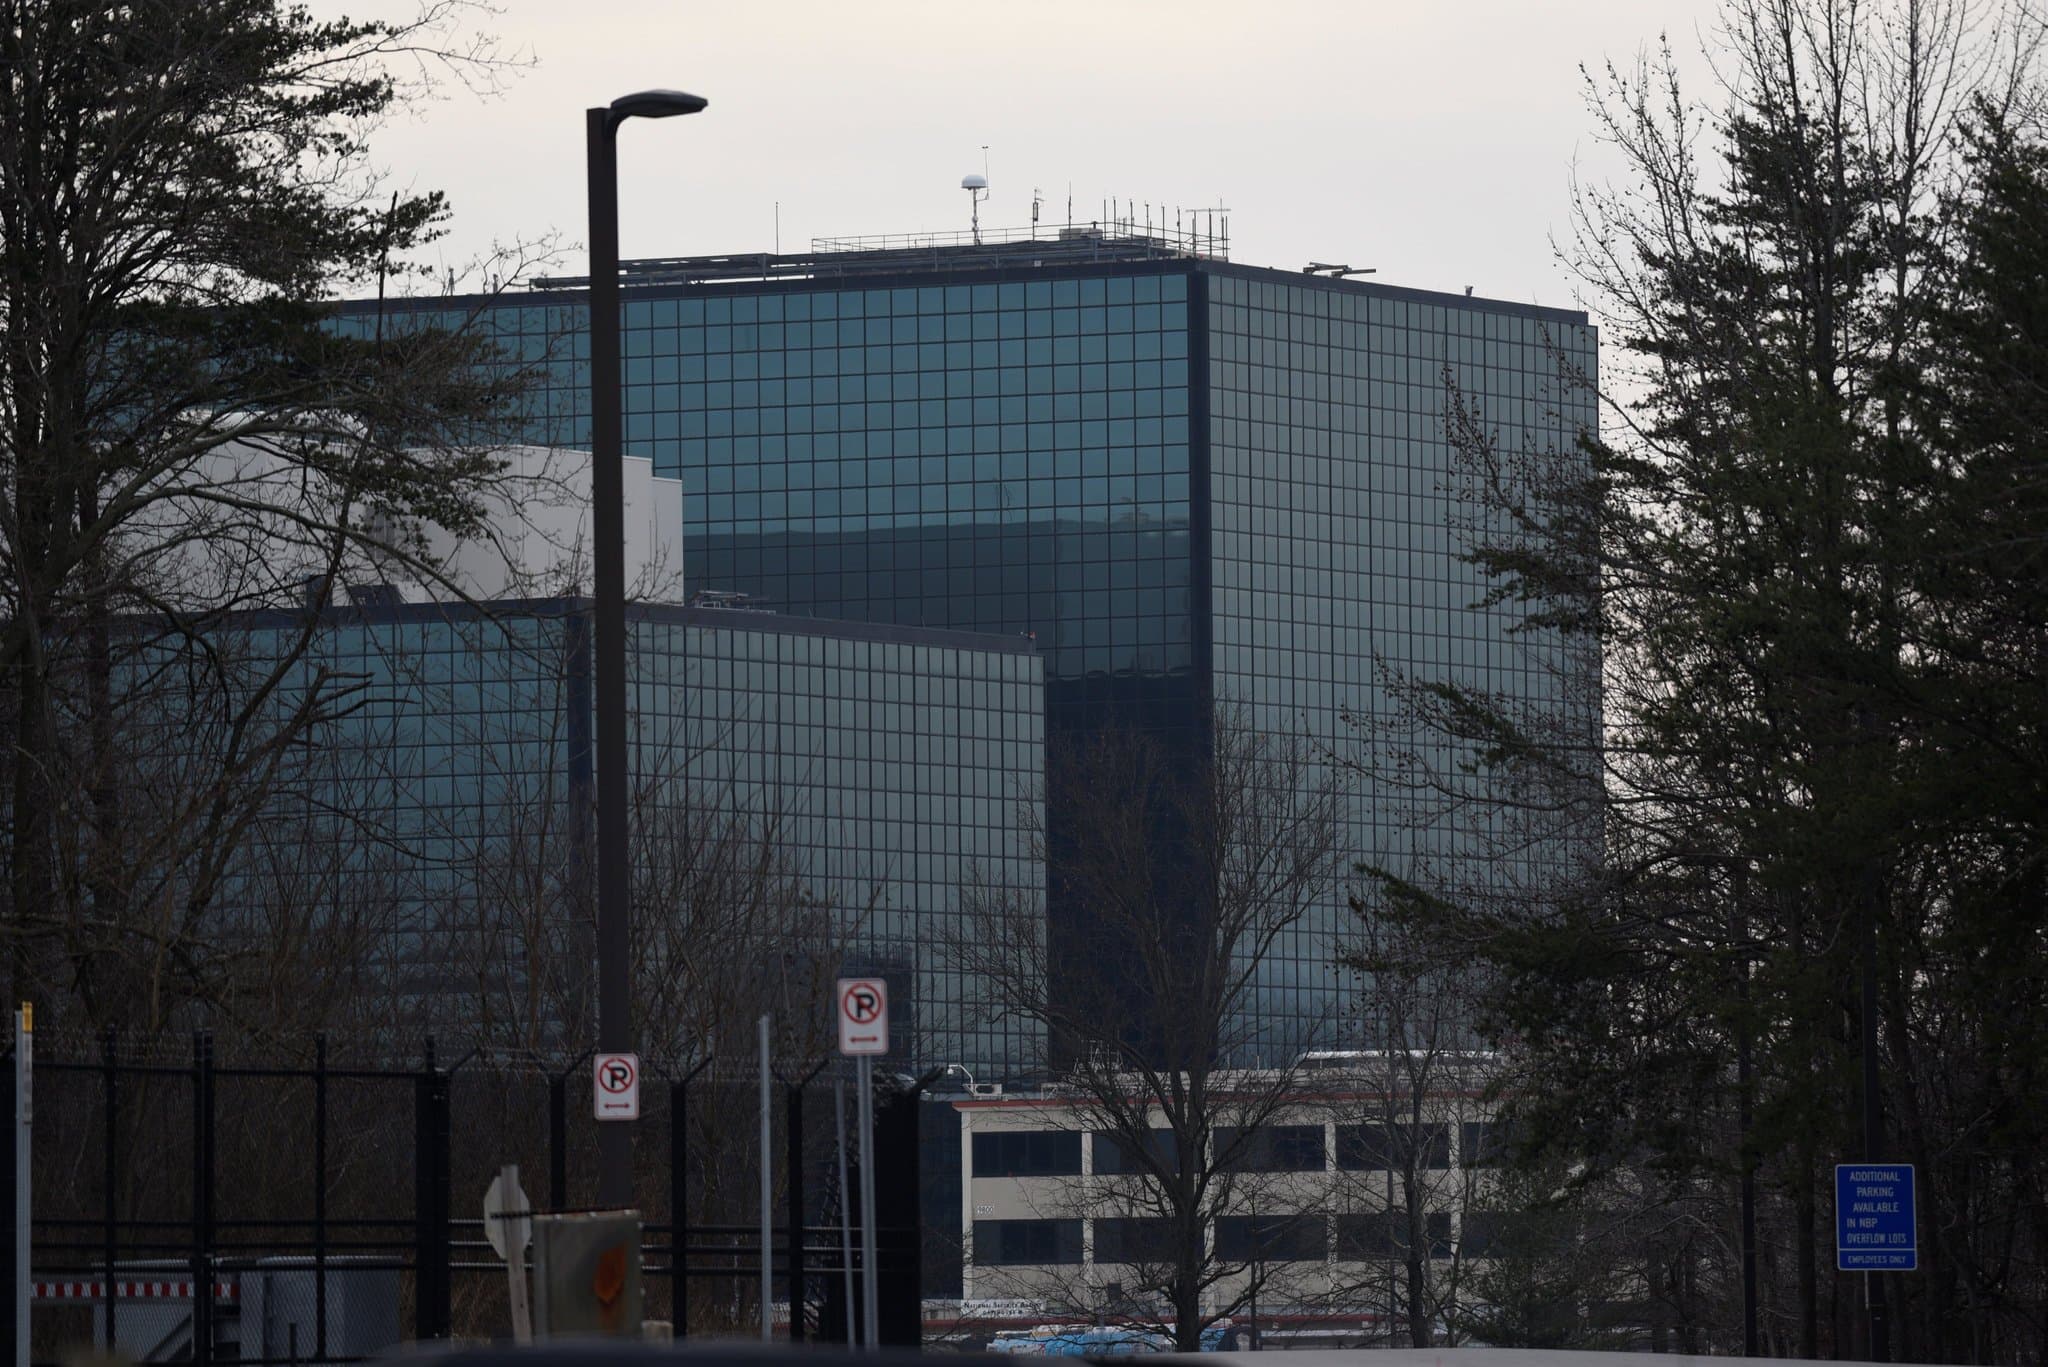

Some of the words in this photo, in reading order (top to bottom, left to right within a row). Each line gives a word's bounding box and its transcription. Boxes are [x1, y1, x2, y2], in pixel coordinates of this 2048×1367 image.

[1849, 1171, 1900, 1181] ADDITIONAL
[1856, 1187, 1894, 1197] PARKING
[1852, 1202, 1900, 1213] AVAILABLE
[1846, 1218, 1856, 1228] IN
[1860, 1218, 1878, 1228] NBP
[1847, 1233, 1886, 1244] OVERFLOW
[1888, 1233, 1907, 1244] LOTS
[1847, 1255, 1888, 1264] EMPLOYEES
[1889, 1255, 1906, 1264] ONLY
